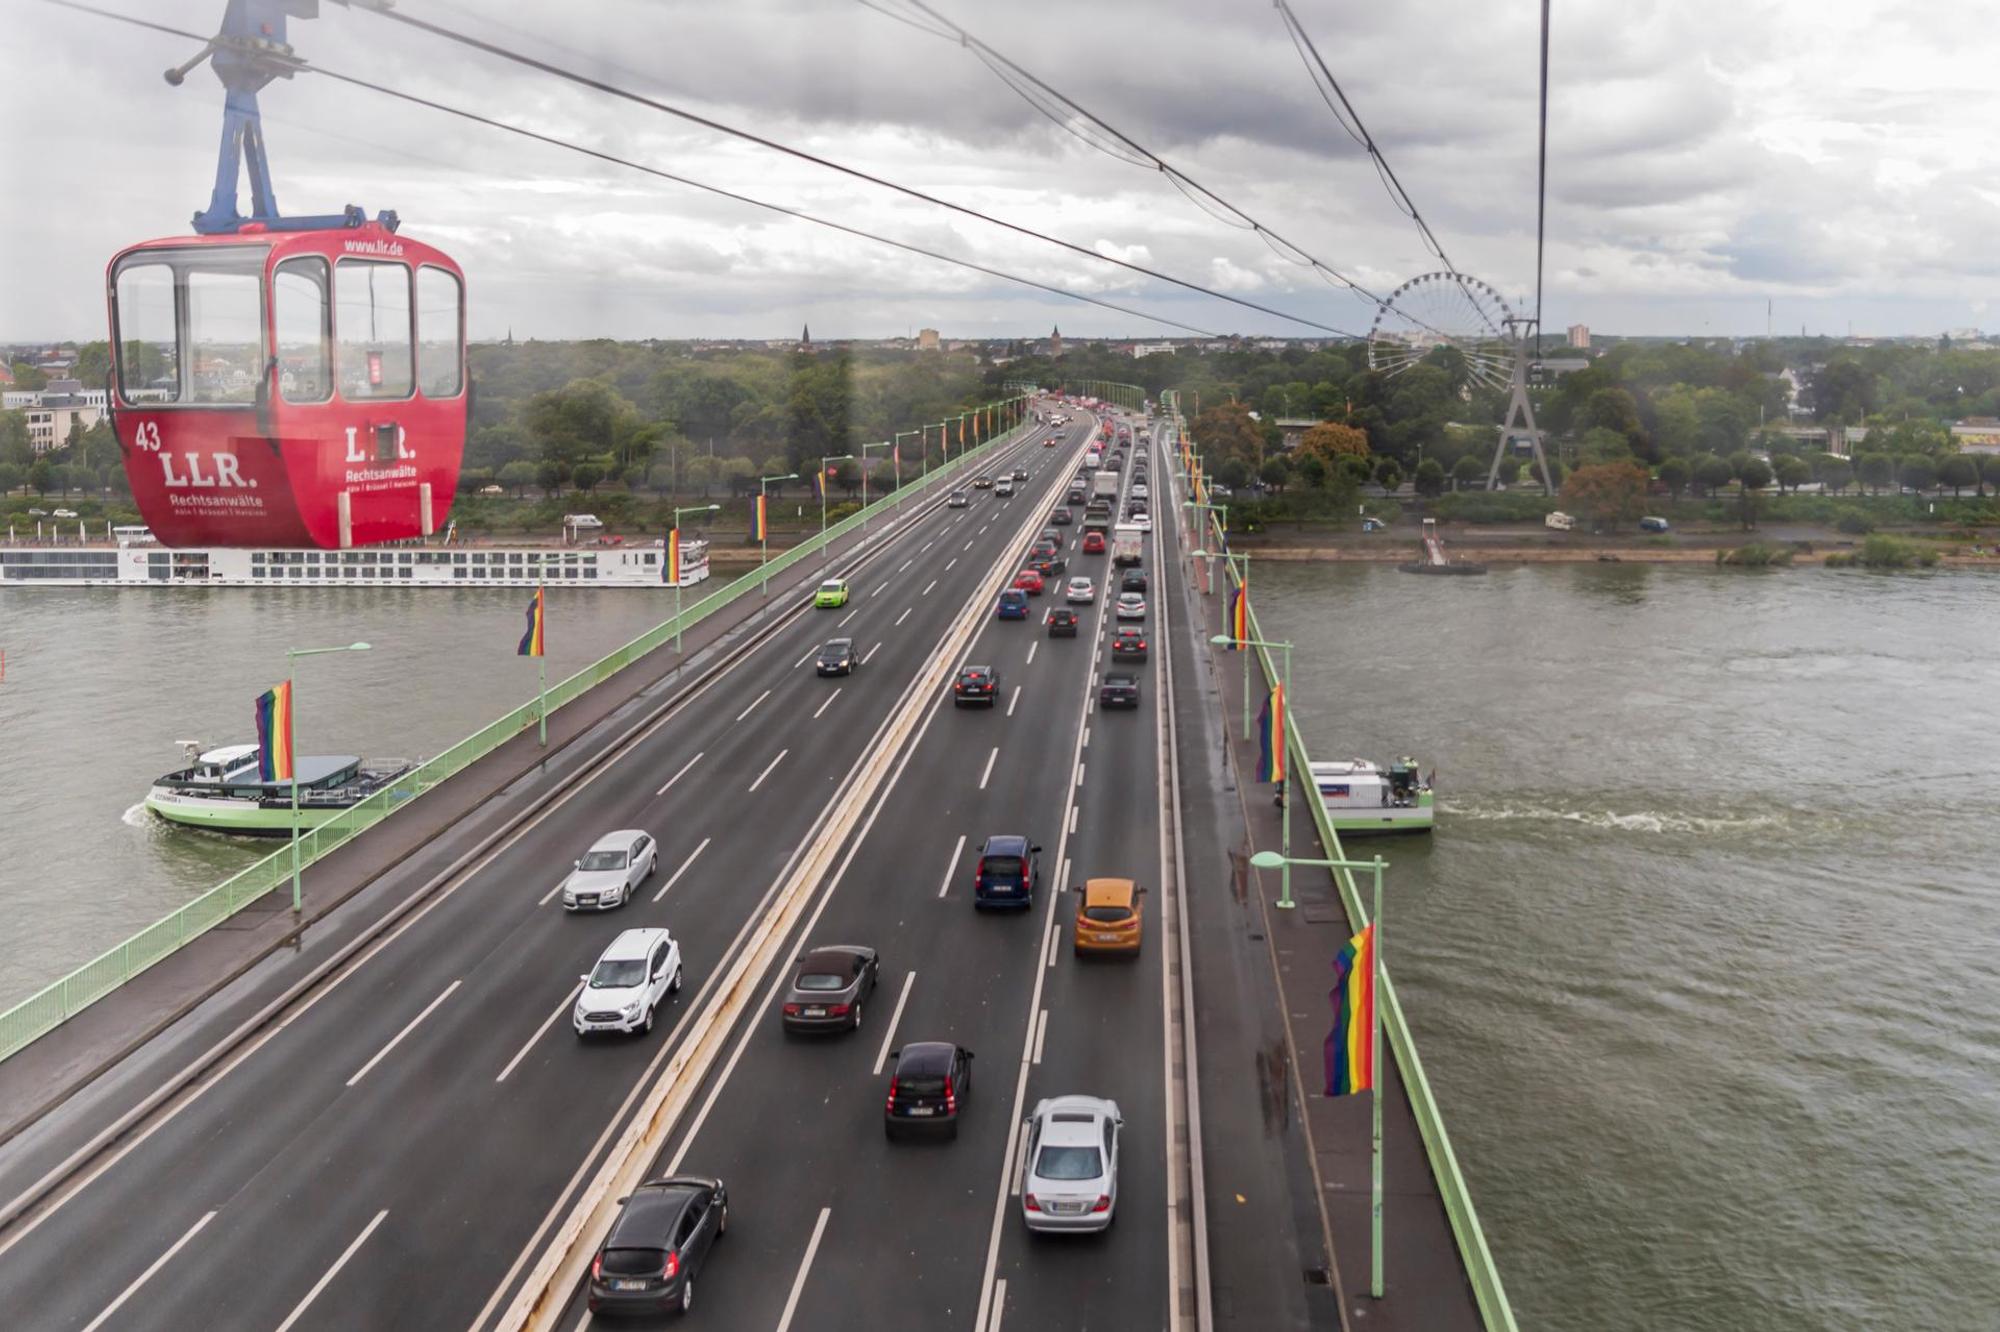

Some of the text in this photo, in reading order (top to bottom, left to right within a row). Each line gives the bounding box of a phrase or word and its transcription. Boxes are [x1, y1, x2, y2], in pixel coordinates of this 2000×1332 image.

[344, 238, 404, 256] www.llr.de
[135, 421, 161, 452] 43
[345, 426, 416, 462] LR.
[158, 452, 258, 488] LLR.
[346, 465, 417, 483] Rechtsanwälte
[169, 493, 263, 508] Rechtsanwälte
